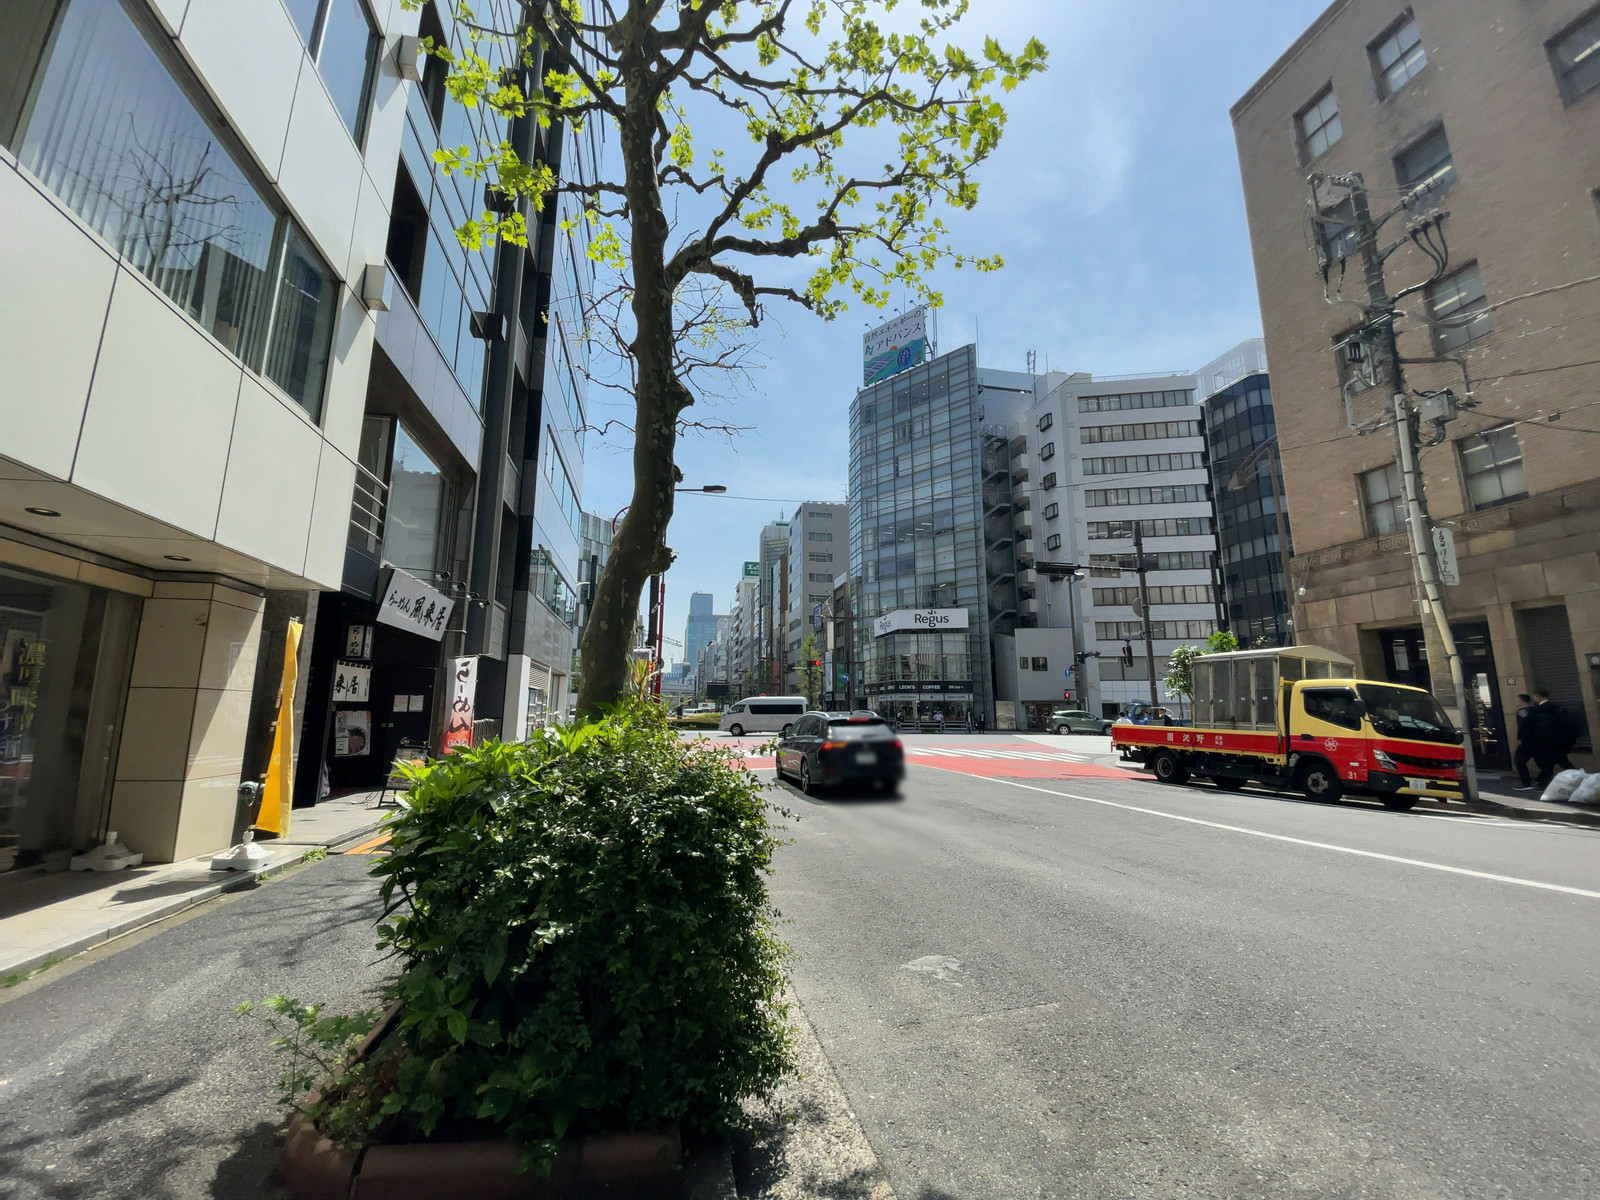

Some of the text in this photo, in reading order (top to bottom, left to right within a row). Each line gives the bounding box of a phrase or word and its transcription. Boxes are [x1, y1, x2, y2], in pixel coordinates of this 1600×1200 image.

[865, 310, 921, 344] 自然エネルギーの
[876, 323, 921, 351] アドバンス
[388, 589, 411, 613] らーめん
[914, 613, 949, 628] Regus
[349, 626, 360, 656] らーめん
[449, 661, 471, 734] らーめん
[1347, 771, 1357, 780] 31
